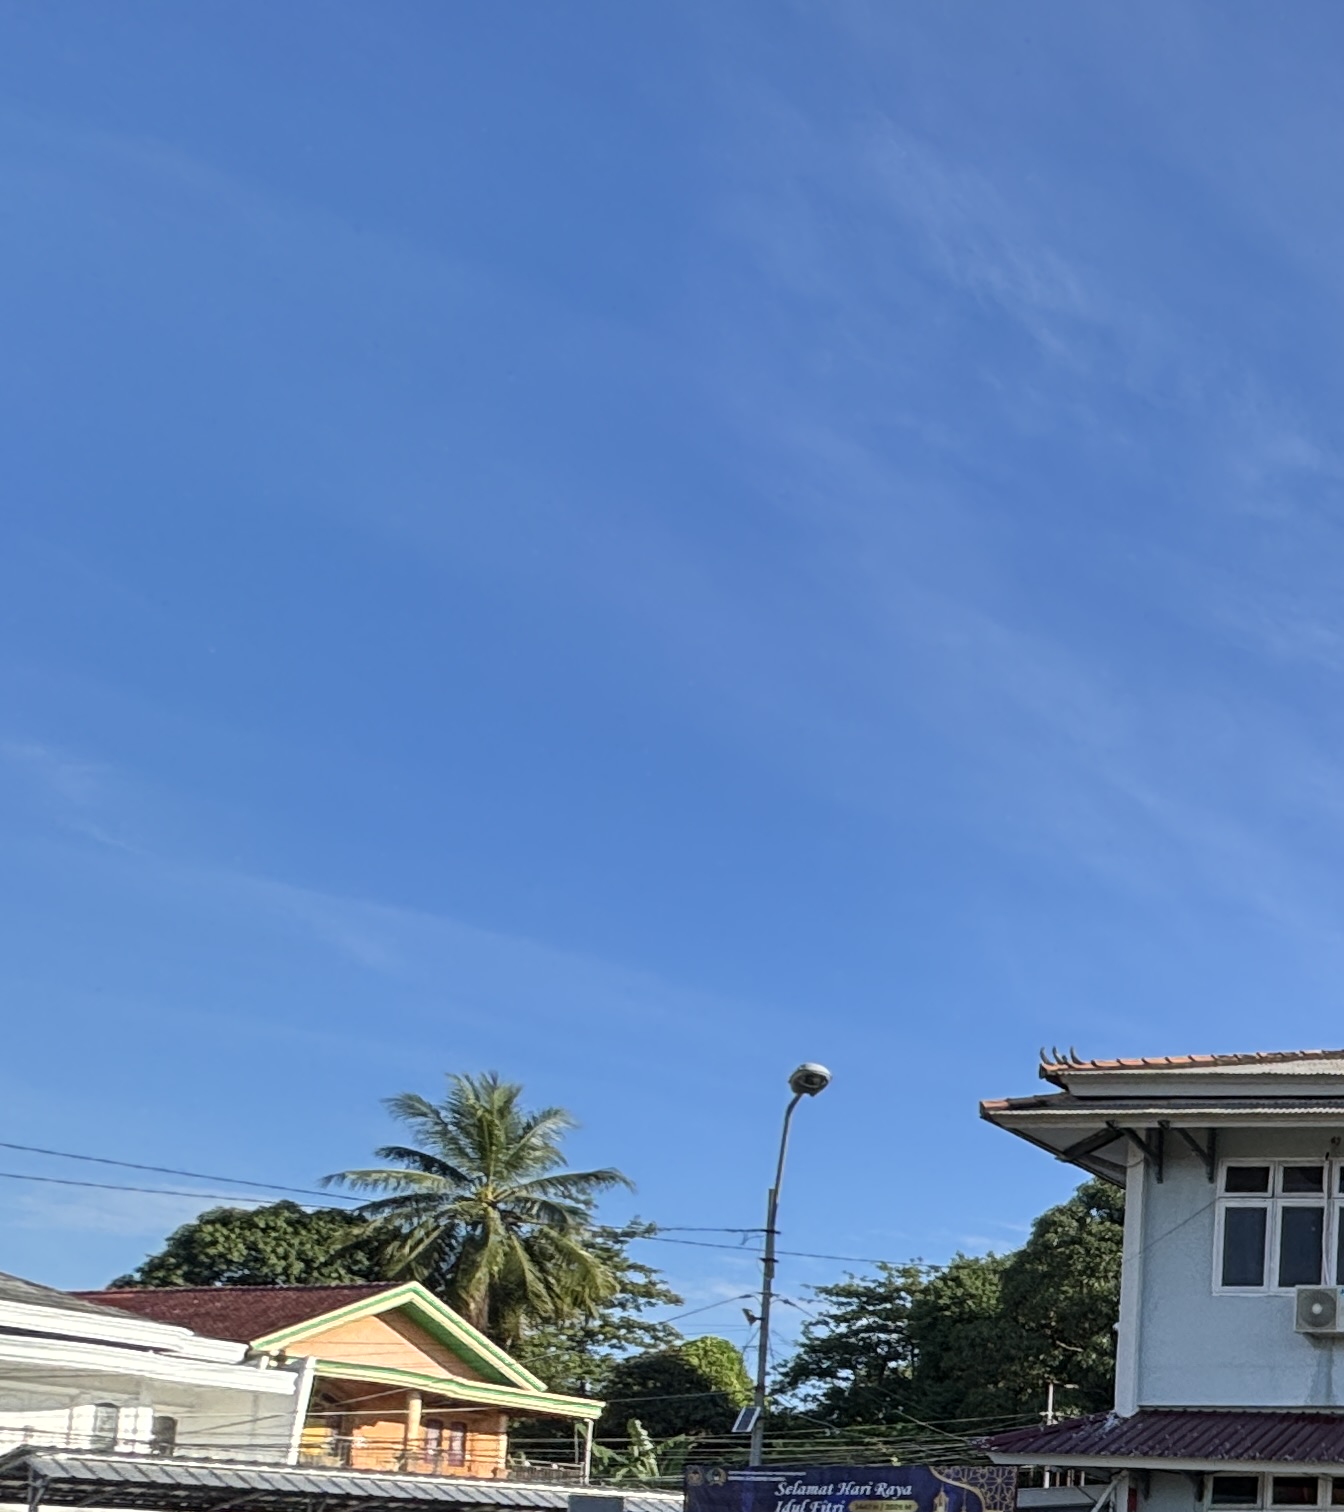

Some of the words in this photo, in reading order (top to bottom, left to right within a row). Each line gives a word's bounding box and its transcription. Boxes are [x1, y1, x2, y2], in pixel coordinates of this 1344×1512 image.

[774, 1480, 834, 1496] Selamat
[836, 1481, 872, 1496] Hari
[874, 1482, 912, 1500] Raya
